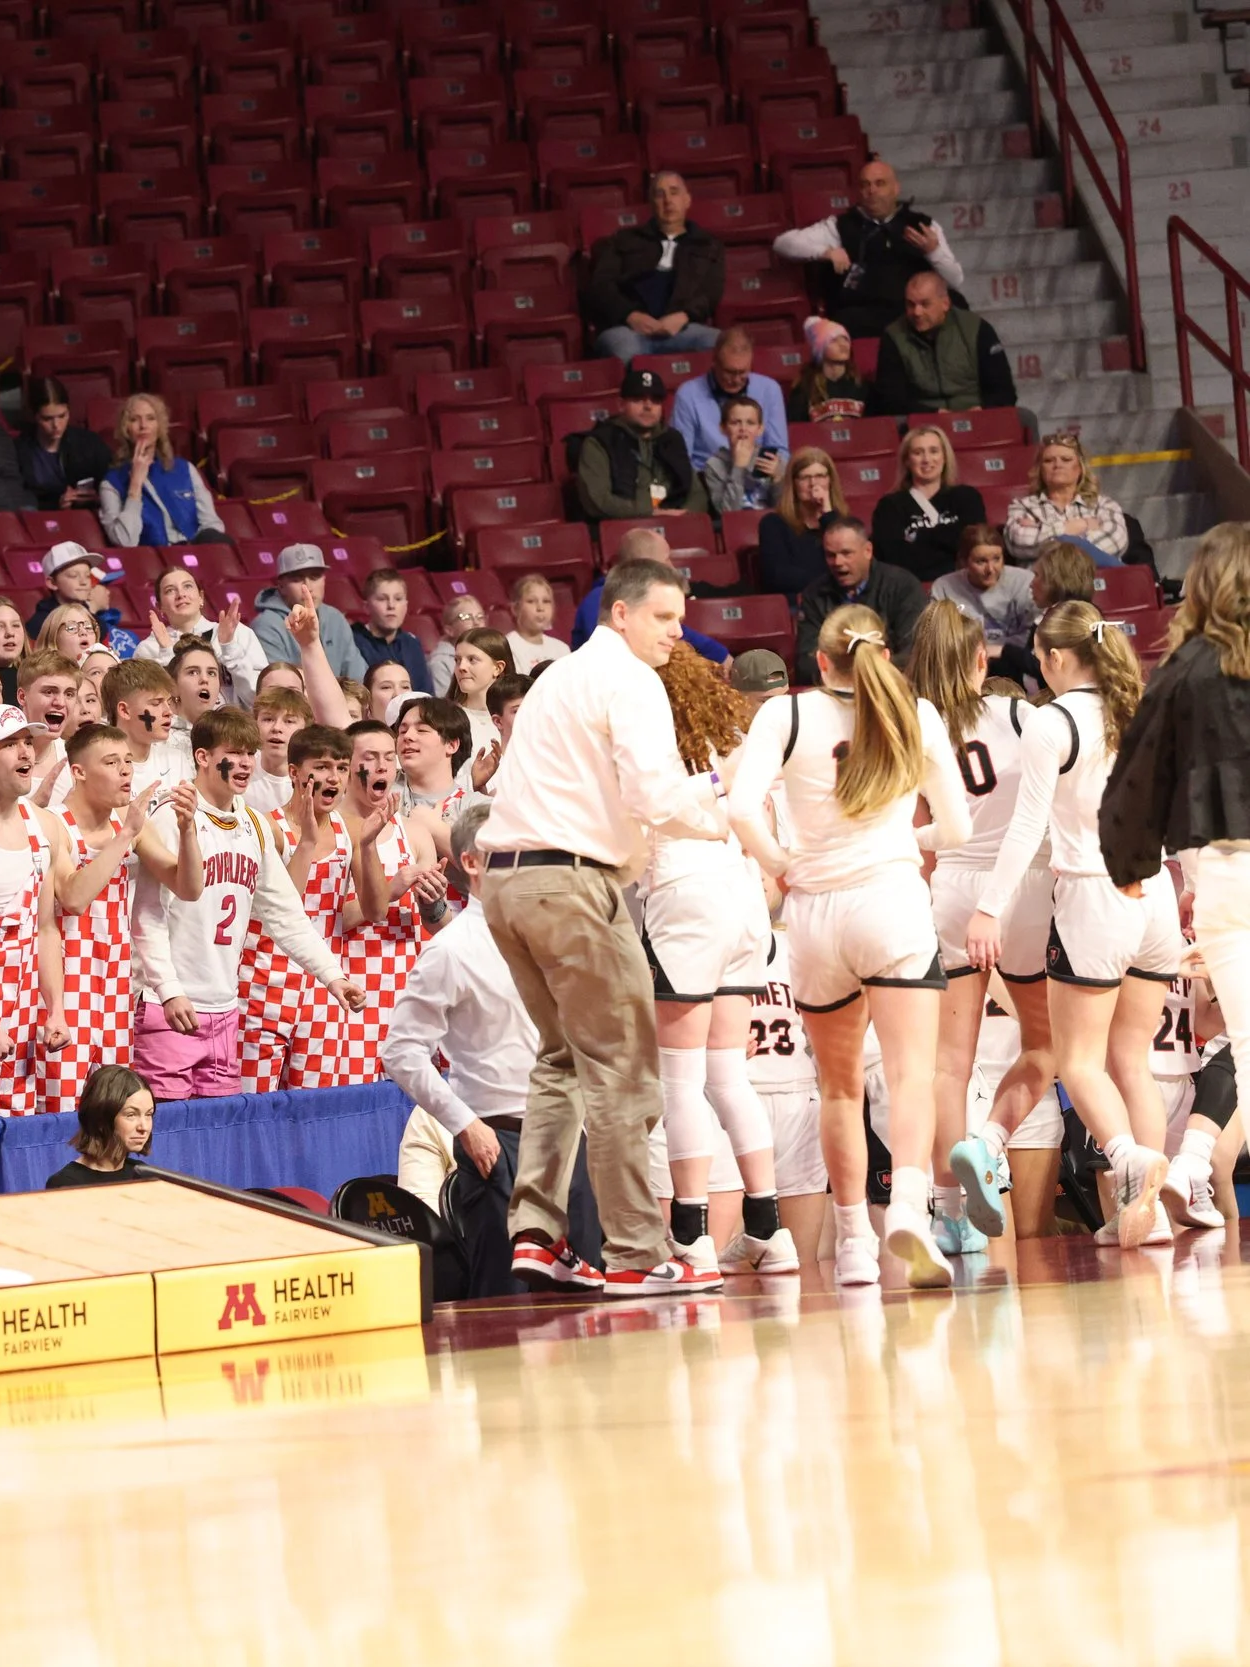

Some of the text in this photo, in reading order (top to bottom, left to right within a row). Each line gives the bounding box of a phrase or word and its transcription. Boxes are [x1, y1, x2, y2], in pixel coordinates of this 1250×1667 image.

[1110, 56, 1132, 75] 25
[894, 70, 926, 98] 22
[1138, 118, 1162, 137] 24
[1168, 182, 1192, 201] 23
[952, 204, 986, 230] 20
[991, 275, 1019, 300] 19
[642, 372, 653, 387] 3
[1017, 354, 1042, 380] 18
[213, 894, 237, 946] 2
[749, 1018, 796, 1057] 23
[1153, 1004, 1194, 1055] 24
[273, 1271, 355, 1303] HEALTH
[2, 1301, 88, 1335] HEALTH
[274, 1305, 332, 1324] FAIRVIEW
[3, 1336, 63, 1357] FAIRVIEW
